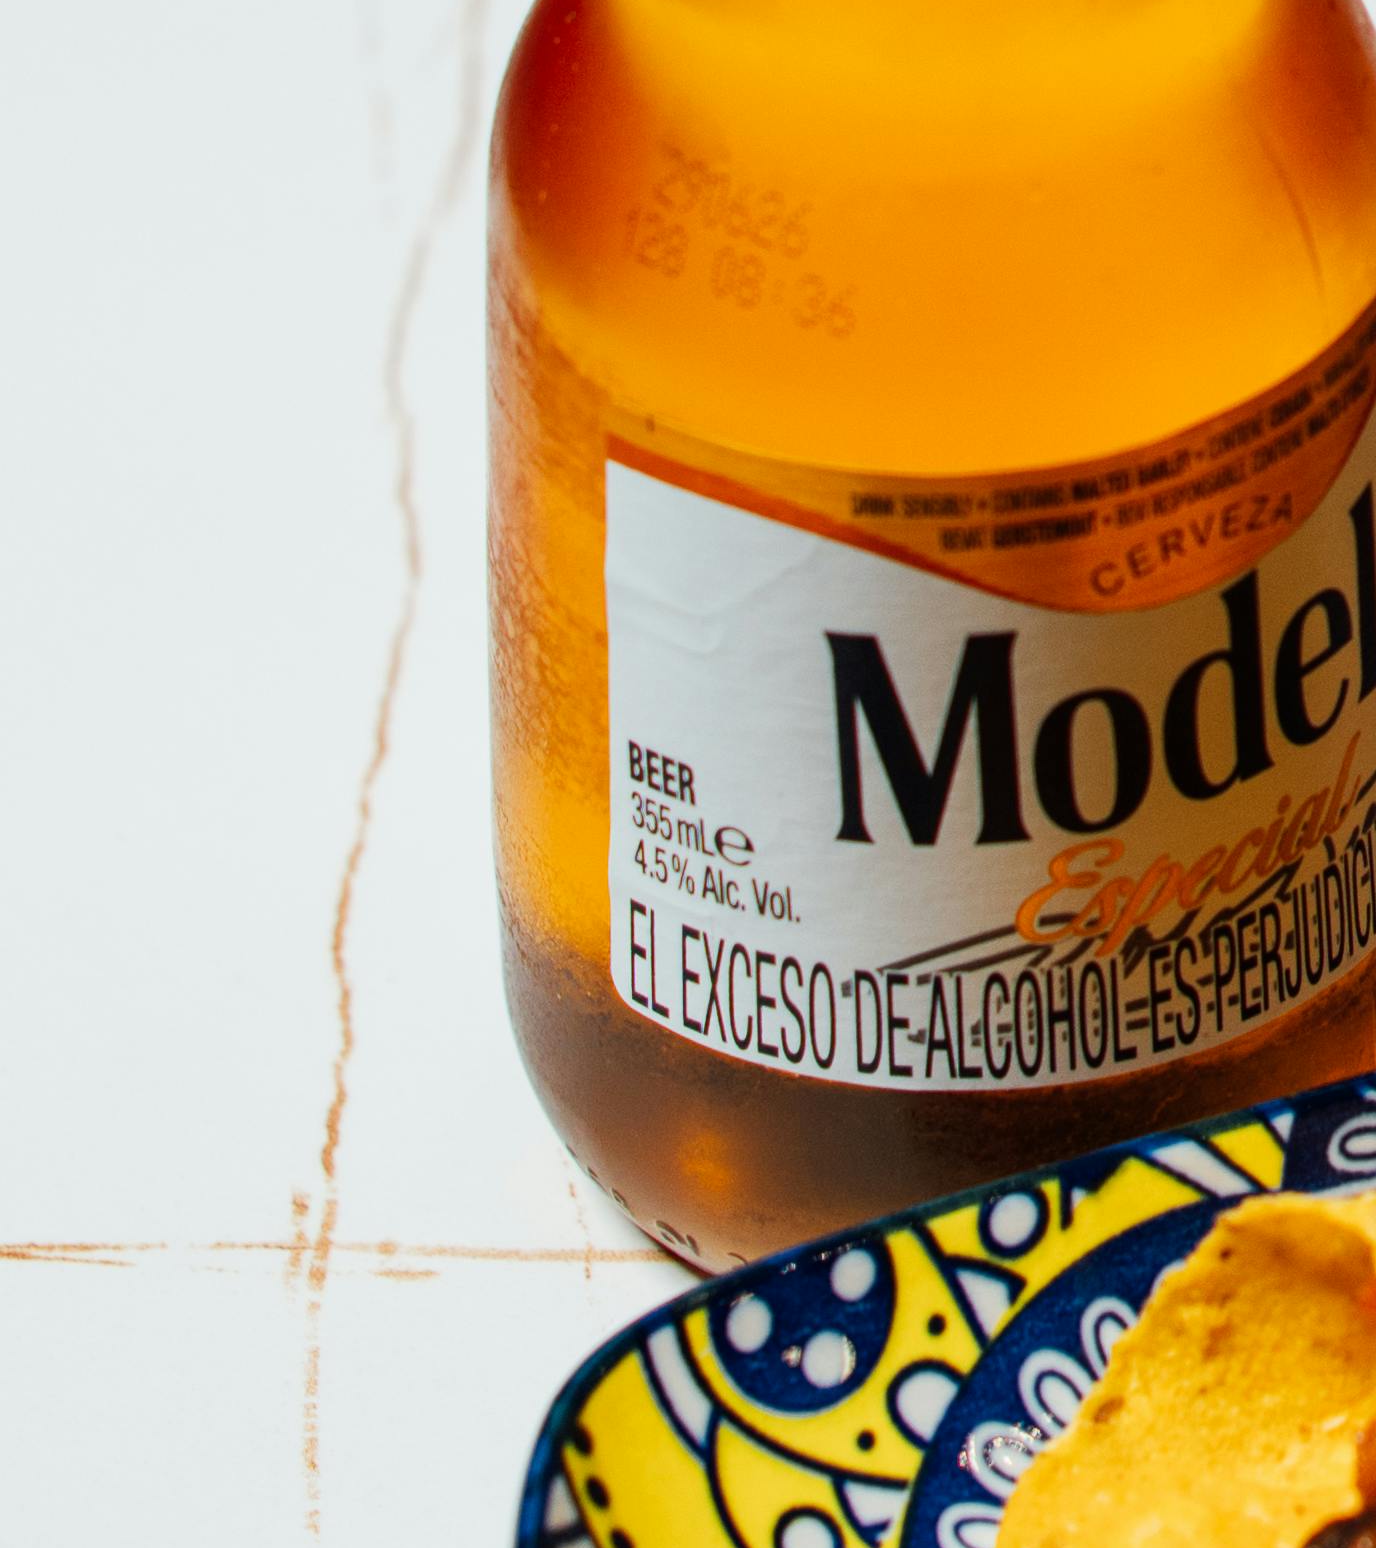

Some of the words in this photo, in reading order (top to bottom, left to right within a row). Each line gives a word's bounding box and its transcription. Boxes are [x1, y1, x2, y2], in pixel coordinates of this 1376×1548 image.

[1089, 492, 1294, 597] CERVEZA
[627, 738, 697, 806] BEER
[631, 790, 674, 842] 355
[1014, 729, 1362, 958] Especial
[701, 864, 747, 913] Alc.
[751, 877, 801, 924] Vol.
[629, 898, 671, 1019] EL
[681, 923, 836, 1071] EXCESO
[853, 968, 914, 1077] DE
[924, 955, 1138, 1080] ALCOHOL
[1149, 935, 1201, 1054] ES
